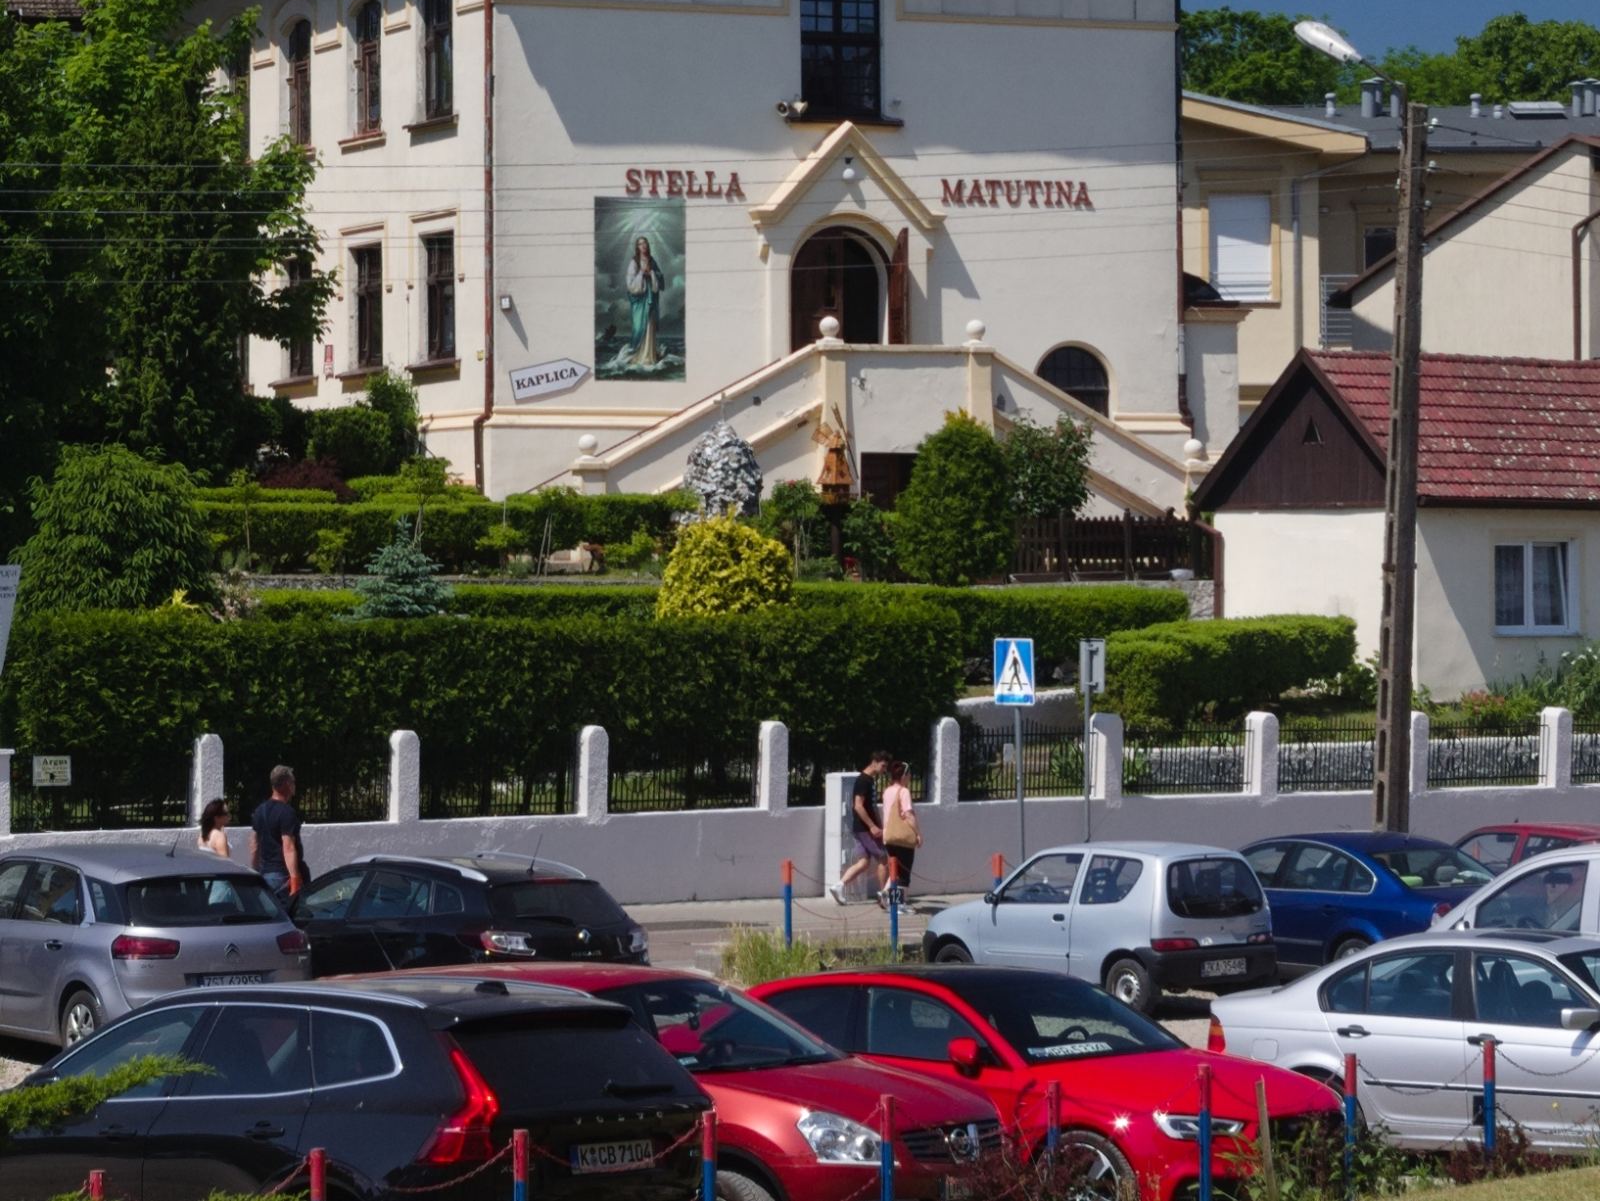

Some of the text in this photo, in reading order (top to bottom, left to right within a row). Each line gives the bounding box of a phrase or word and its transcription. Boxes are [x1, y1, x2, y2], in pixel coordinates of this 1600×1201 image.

[625, 168, 745, 197] STELLA
[941, 178, 1094, 210] MATUTINA
[515, 366, 579, 390] KAPLICA
[891, 889, 901, 903] 12
